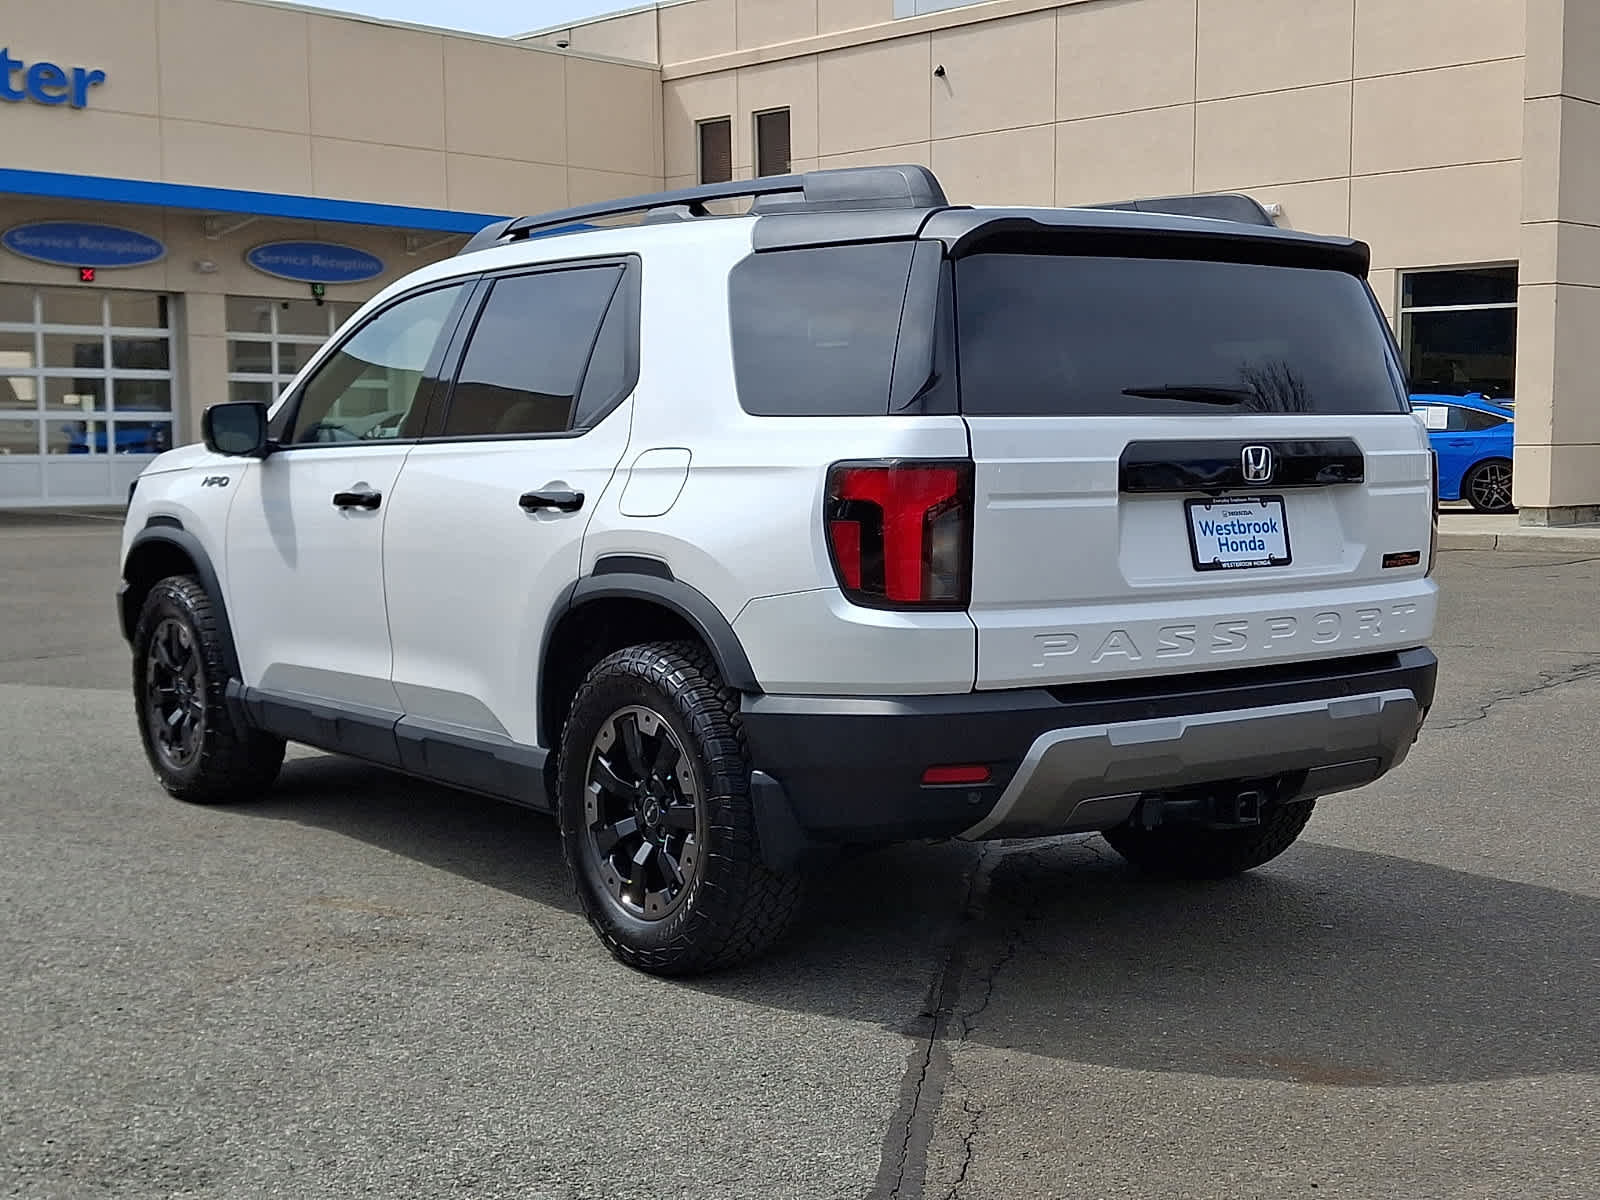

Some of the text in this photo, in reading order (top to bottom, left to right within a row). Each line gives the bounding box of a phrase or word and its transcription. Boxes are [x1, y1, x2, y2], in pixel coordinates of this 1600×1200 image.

[1199, 517, 1278, 537] Westbrook
[1217, 535, 1265, 552] Honda
[1032, 603, 1417, 667] PASSPORT
